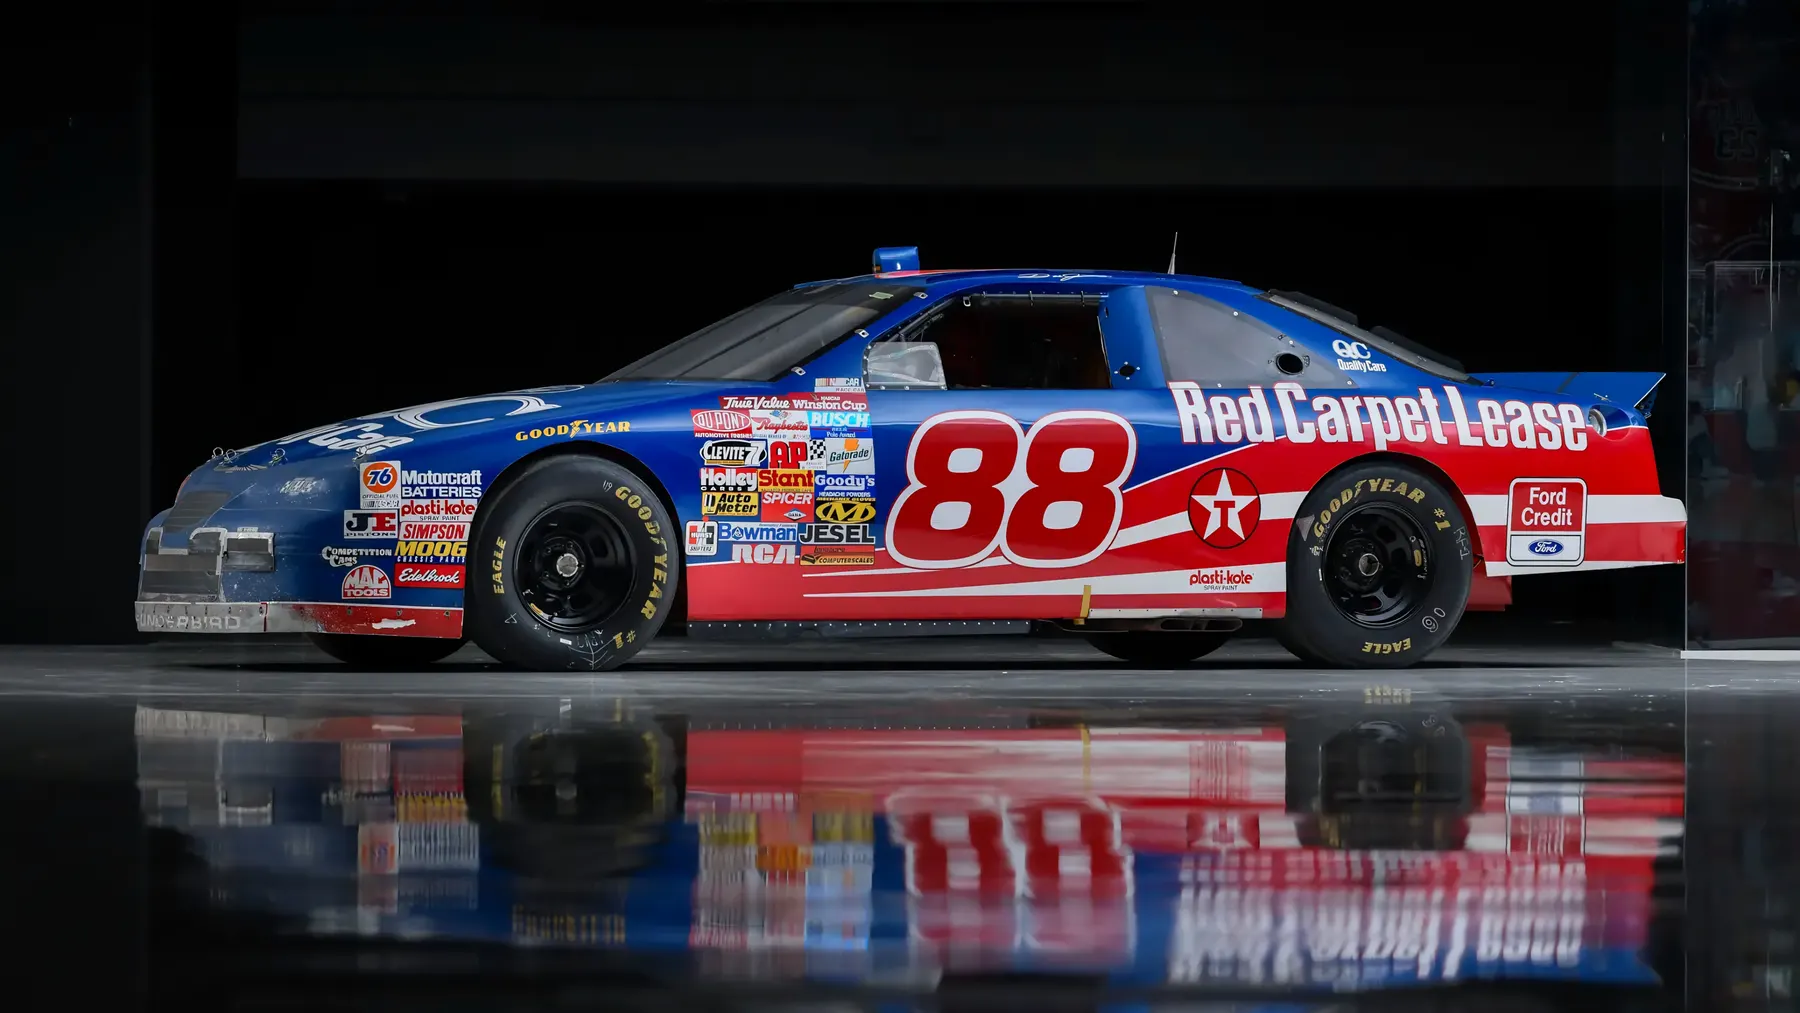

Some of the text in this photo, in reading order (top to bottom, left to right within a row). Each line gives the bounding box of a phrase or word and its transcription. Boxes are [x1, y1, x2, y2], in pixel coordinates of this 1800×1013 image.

[1332, 340, 1371, 359] QC
[1337, 359, 1387, 372] Quality Care
[723, 397, 790, 409] True Value
[792, 400, 866, 411] Winston Cup
[810, 412, 870, 427] BUSCH
[1167, 381, 1589, 451] Red Carpet Lease
[516, 420, 631, 441] GOODYEAR
[770, 441, 807, 469] AP
[830, 449, 869, 462] Gatorade
[367, 467, 393, 486] 76
[402, 470, 482, 485] Motorcraft
[700, 468, 758, 491] Holley
[759, 470, 814, 487] Stant
[815, 475, 875, 490] Goody's
[402, 487, 482, 497] BATTERIES
[888, 412, 1133, 567] 88
[1529, 487, 1566, 505] Ford
[719, 494, 751, 503] Auto
[762, 493, 812, 505] SPICER
[401, 500, 475, 516] plasti-kote
[716, 504, 757, 513] Meter
[1313, 478, 1426, 538] GOODYEAR
[346, 513, 396, 531] JE
[1521, 507, 1572, 526] Credit
[403, 524, 465, 539] SIMPSON
[800, 525, 875, 543] JESEL
[395, 541, 468, 557] MOOG
[732, 544, 796, 564] RCA
[1535, 541, 1557, 553] Ford
[492, 536, 507, 594] EAGLE
[344, 567, 388, 588] MAC
[399, 568, 460, 583] Edelbrock
[1190, 570, 1253, 586] plasti-kote
[344, 589, 388, 597] TOOLS
[1361, 637, 1412, 654] EAGLE
